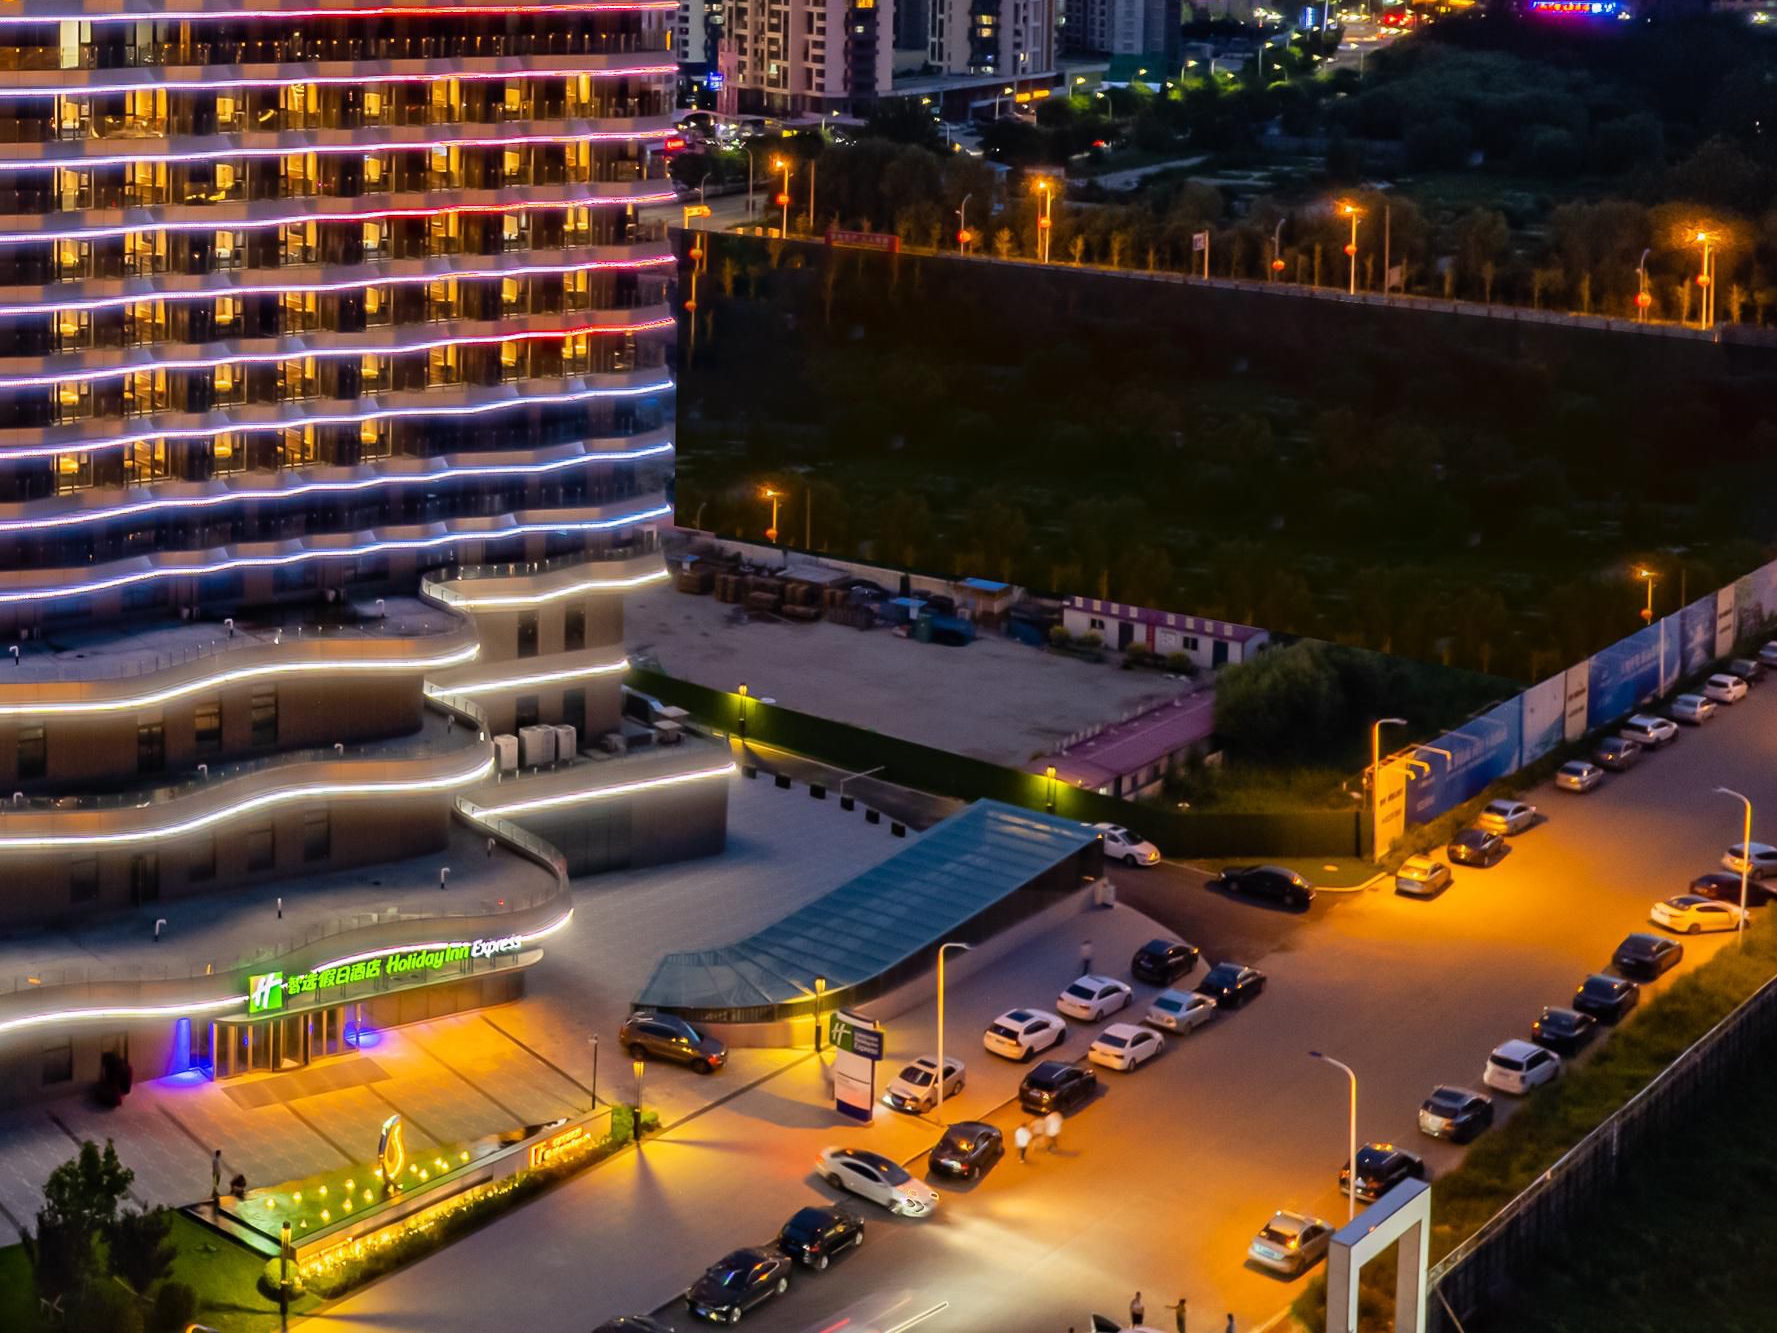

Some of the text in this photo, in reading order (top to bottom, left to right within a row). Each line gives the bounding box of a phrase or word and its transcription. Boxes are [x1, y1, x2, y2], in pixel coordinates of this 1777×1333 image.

[288, 959, 382, 995] 智选假日酒店
